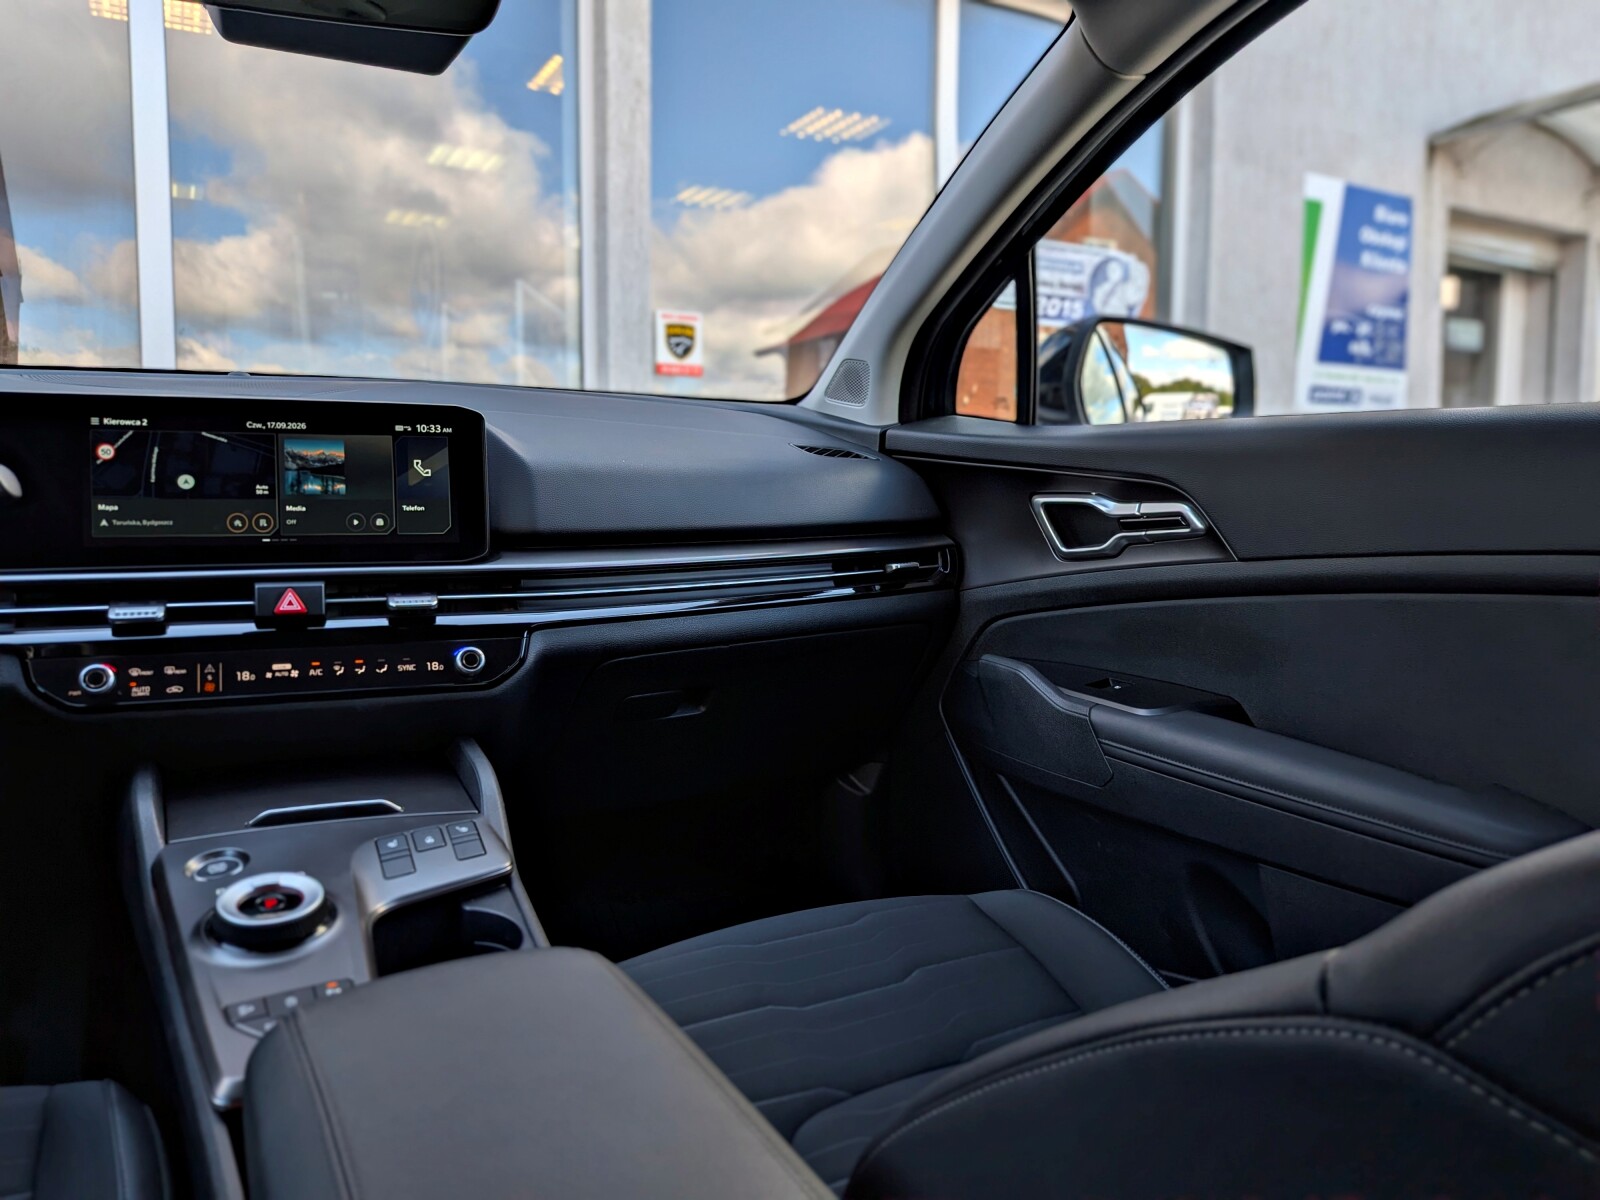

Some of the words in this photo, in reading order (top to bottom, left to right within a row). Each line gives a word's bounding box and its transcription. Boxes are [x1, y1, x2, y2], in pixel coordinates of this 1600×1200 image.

[103, 417, 141, 426] Kierowca
[142, 418, 148, 426] 2
[246, 421, 266, 430] Czw.,
[267, 421, 307, 430] 17.09.2026
[416, 424, 441, 433] 10:33
[100, 448, 112, 456] 50
[97, 504, 119, 512] Mapa
[308, 668, 324, 676] A/C
[397, 664, 417, 672] SYNC
